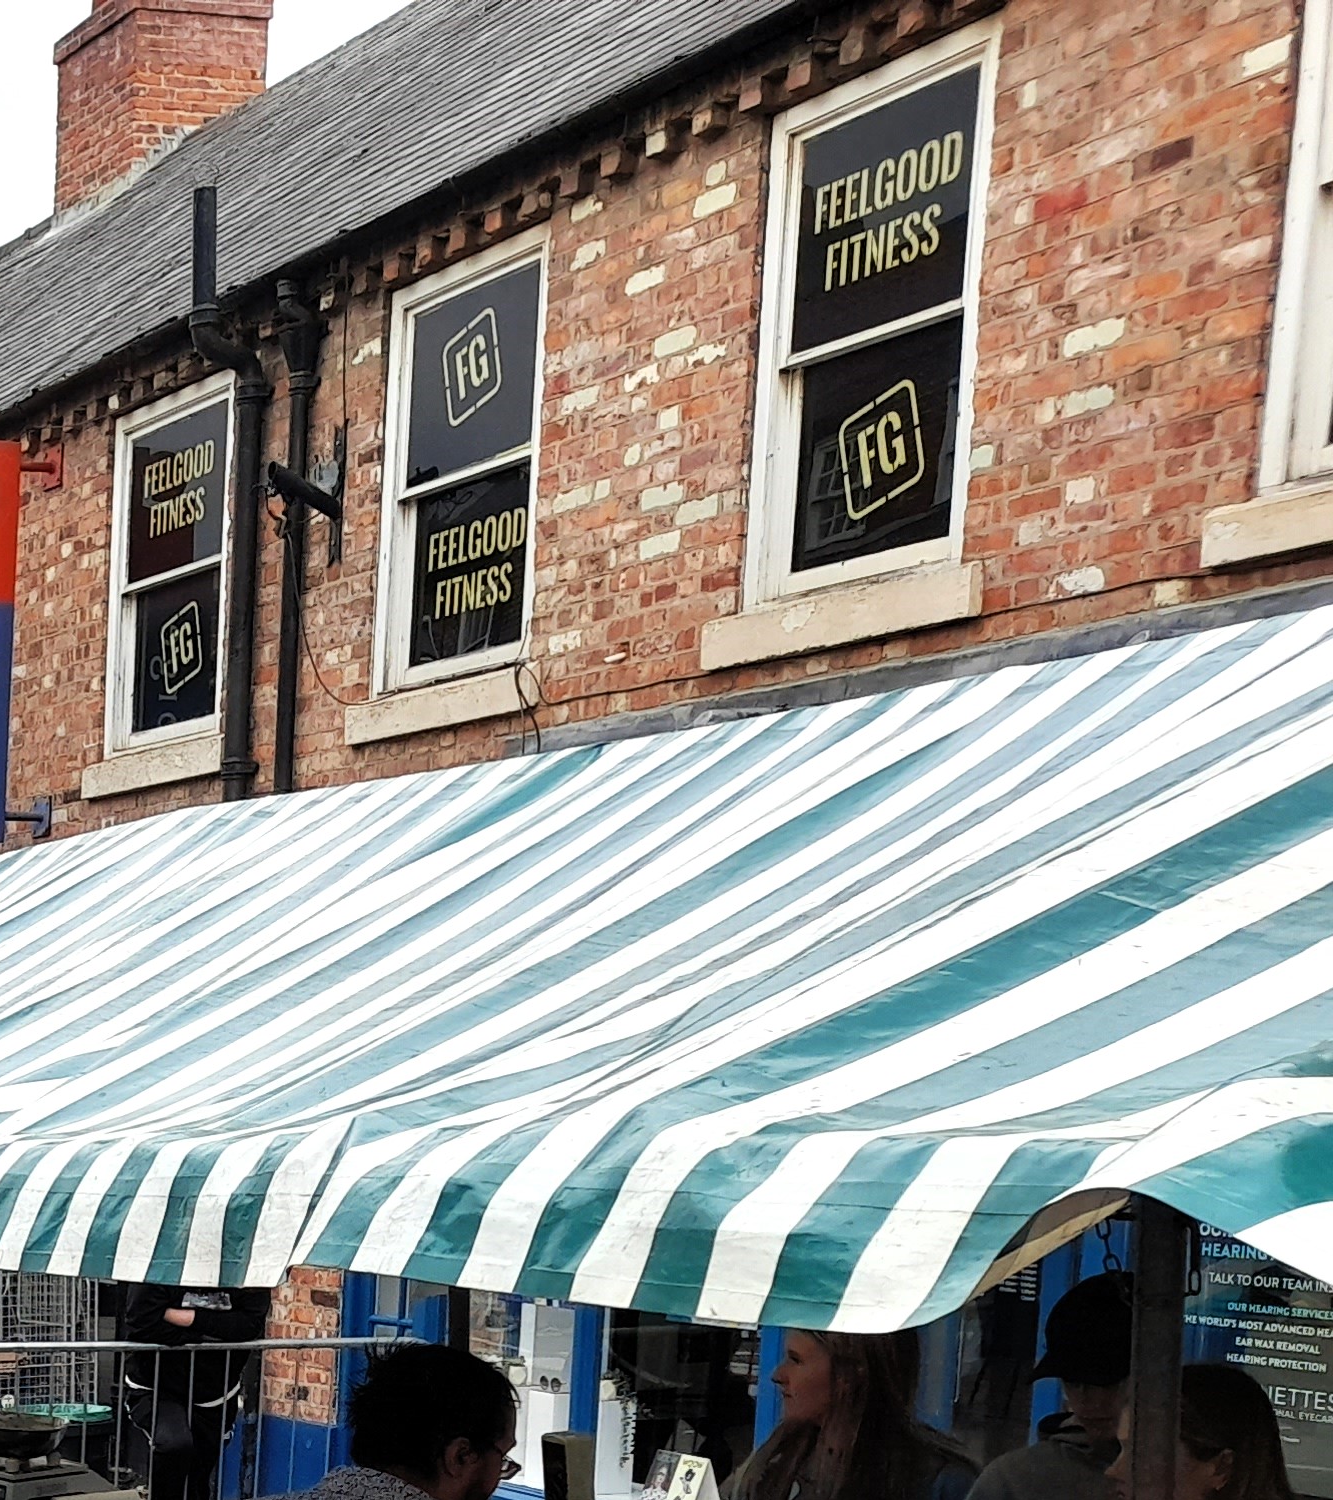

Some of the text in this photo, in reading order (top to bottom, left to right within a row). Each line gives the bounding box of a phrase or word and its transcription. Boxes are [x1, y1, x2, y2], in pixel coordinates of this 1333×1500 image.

[814, 131, 963, 235] FEELGOOD
[824, 204, 942, 292] FITNESS
[455, 333, 489, 401] FG
[144, 439, 214, 499] FEELGOOD
[857, 411, 906, 490] FG
[149, 487, 205, 538] FITNESS
[428, 507, 527, 572] FEELGOOD
[435, 562, 513, 619] FITNESS
[170, 622, 193, 674] FG
[1209, 1271, 1234, 1285] TALK
[1237, 1274, 1252, 1287] TO
[1253, 1275, 1279, 1289] OUR
[1282, 1278, 1313, 1292] TEAM
[1199, 1315, 1237, 1329] WORLD'S
[1238, 1320, 1263, 1331] MOST
[1264, 1323, 1315, 1337] ADVANCED
[1227, 1301, 1247, 1312] OUR
[1249, 1304, 1290, 1317] HEARING
[1226, 1353, 1327, 1373] HEARING PROTECTION
[1235, 1336, 1321, 1355] EAR WAX REMOVAL
